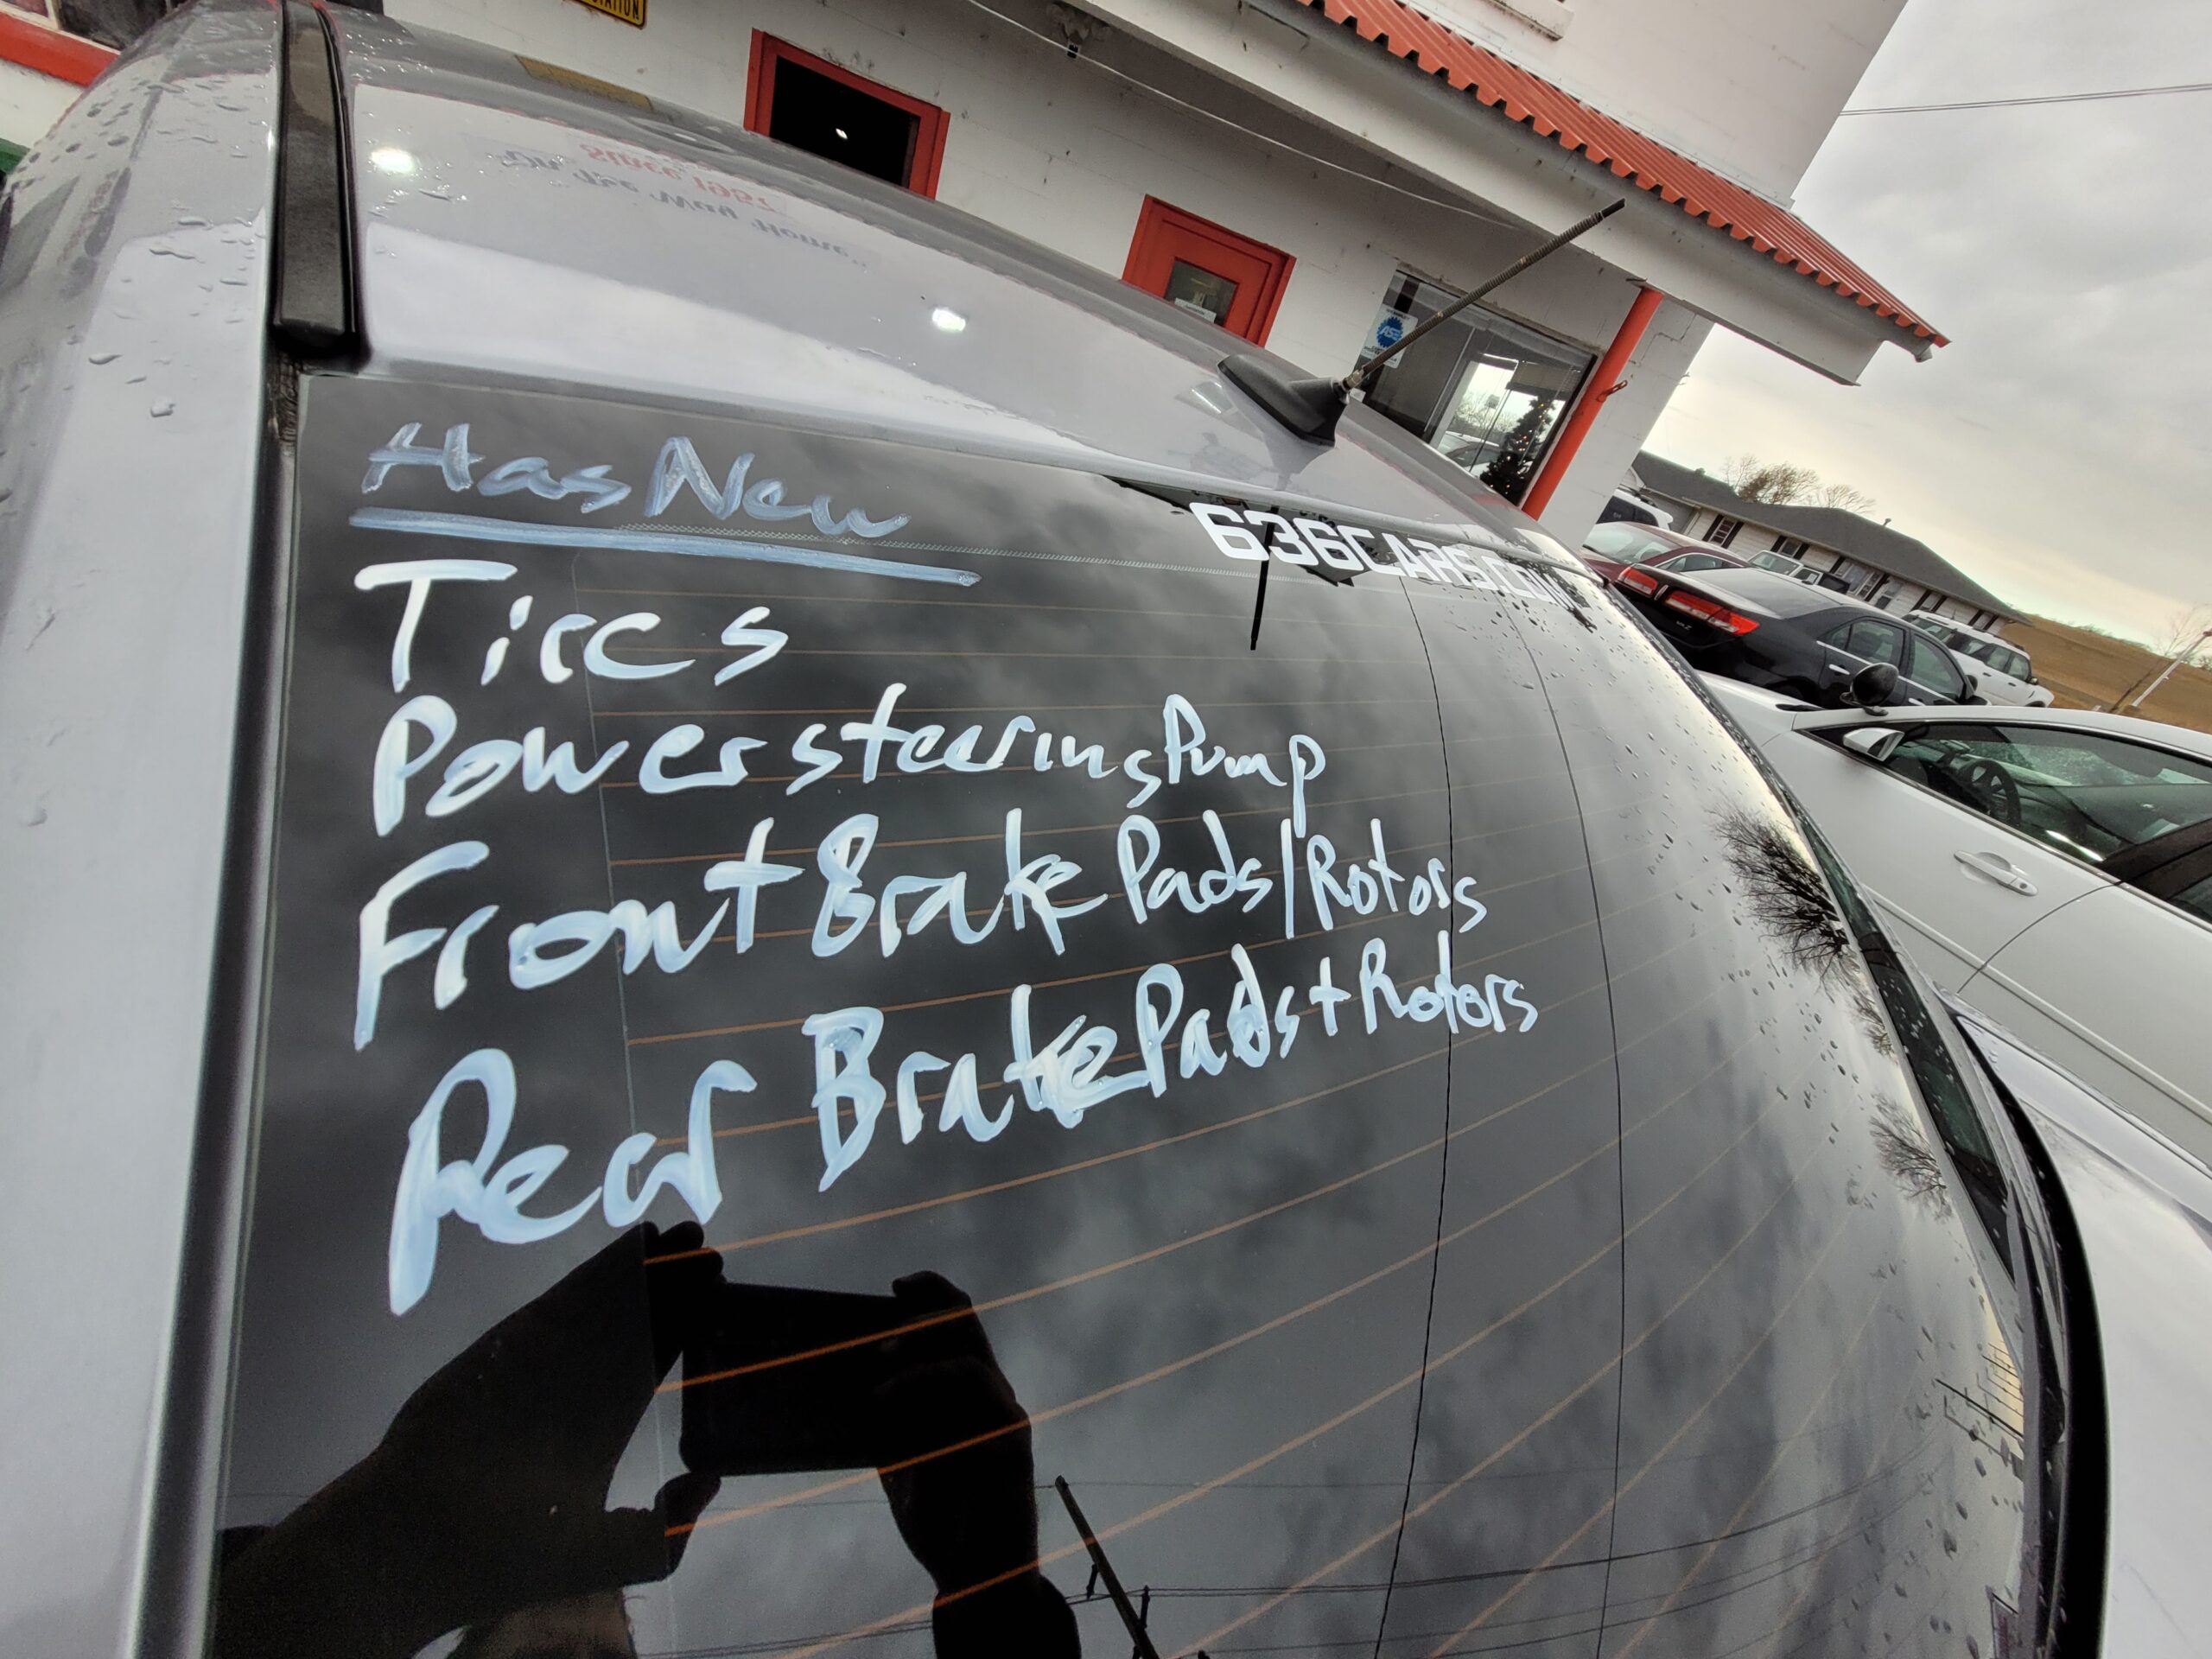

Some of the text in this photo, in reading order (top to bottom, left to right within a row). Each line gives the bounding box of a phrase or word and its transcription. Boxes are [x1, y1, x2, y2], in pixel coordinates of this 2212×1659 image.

[593, 0, 640, 21] TION
[1377, 325, 1401, 341] ASE
[361, 422, 912, 538] Has New
[354, 816, 805, 1052] Front
[811, 807, 1109, 957] Brake
[388, 1048, 758, 1317] Rear
[801, 983, 1148, 1193] Brake
[1359, 930, 1539, 1035] Rotors
